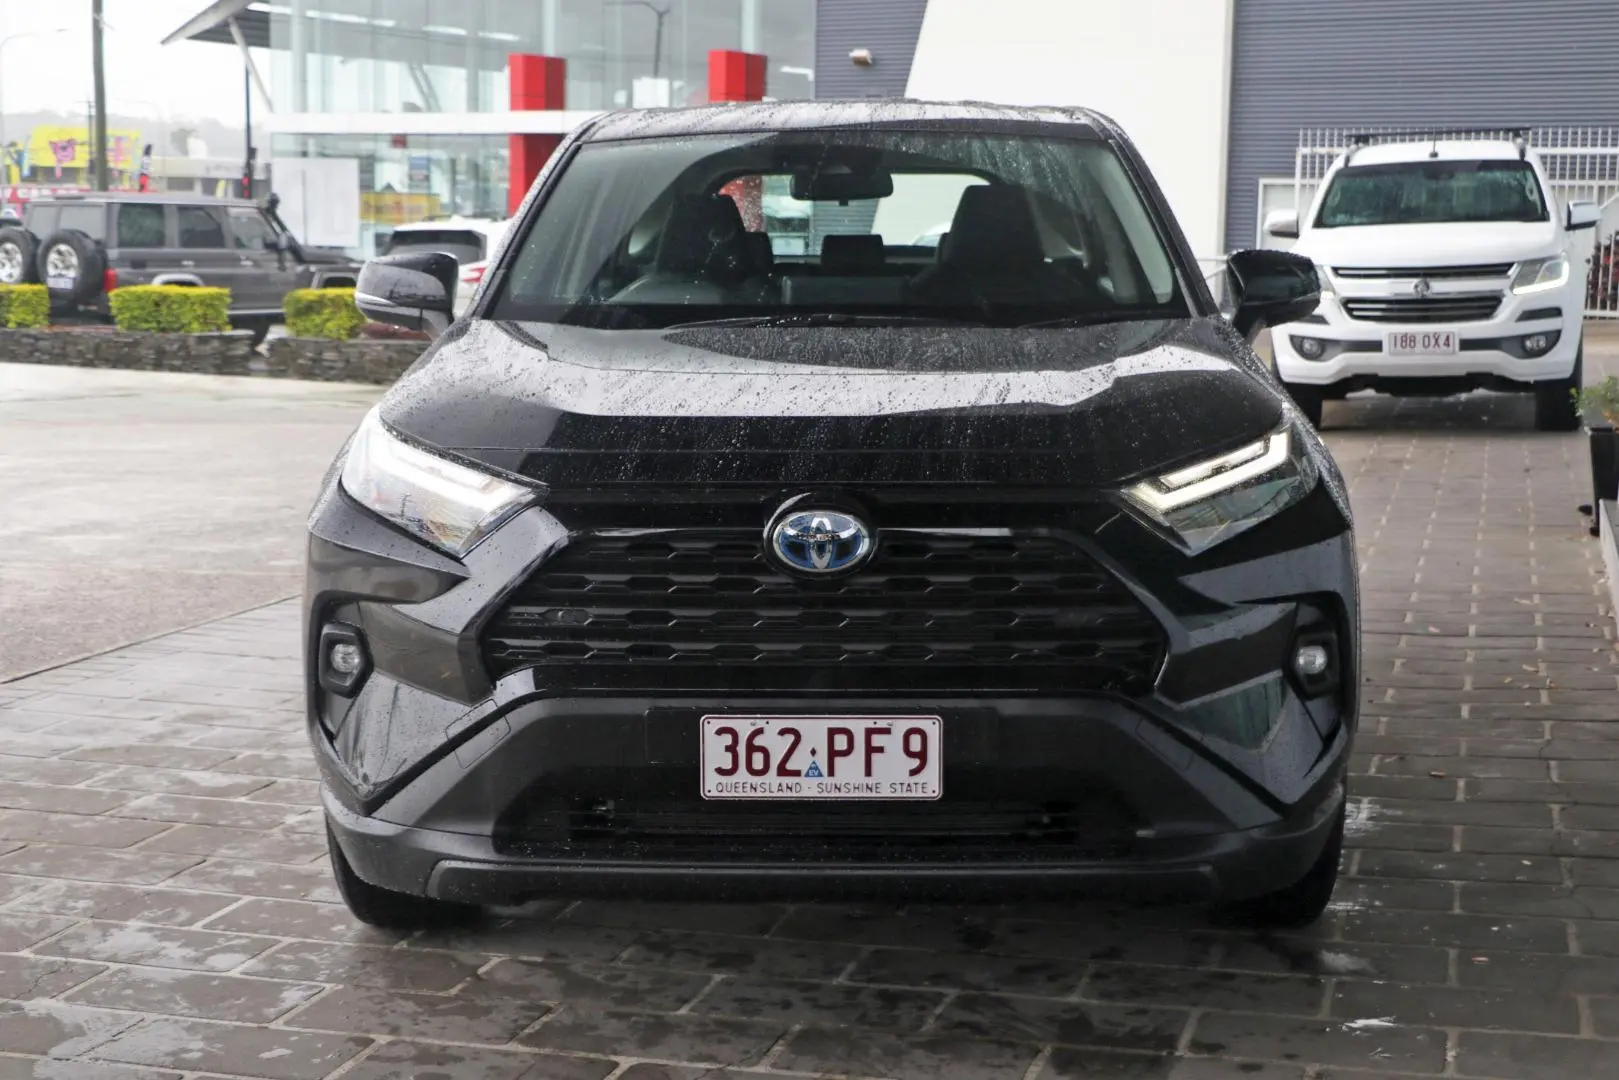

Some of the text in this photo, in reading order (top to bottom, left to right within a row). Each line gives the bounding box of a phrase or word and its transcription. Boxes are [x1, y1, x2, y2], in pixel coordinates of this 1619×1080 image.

[715, 782, 802, 794] QUEENSLAND
[816, 782, 882, 793] SUNSHINE
[889, 782, 929, 793] STATE
